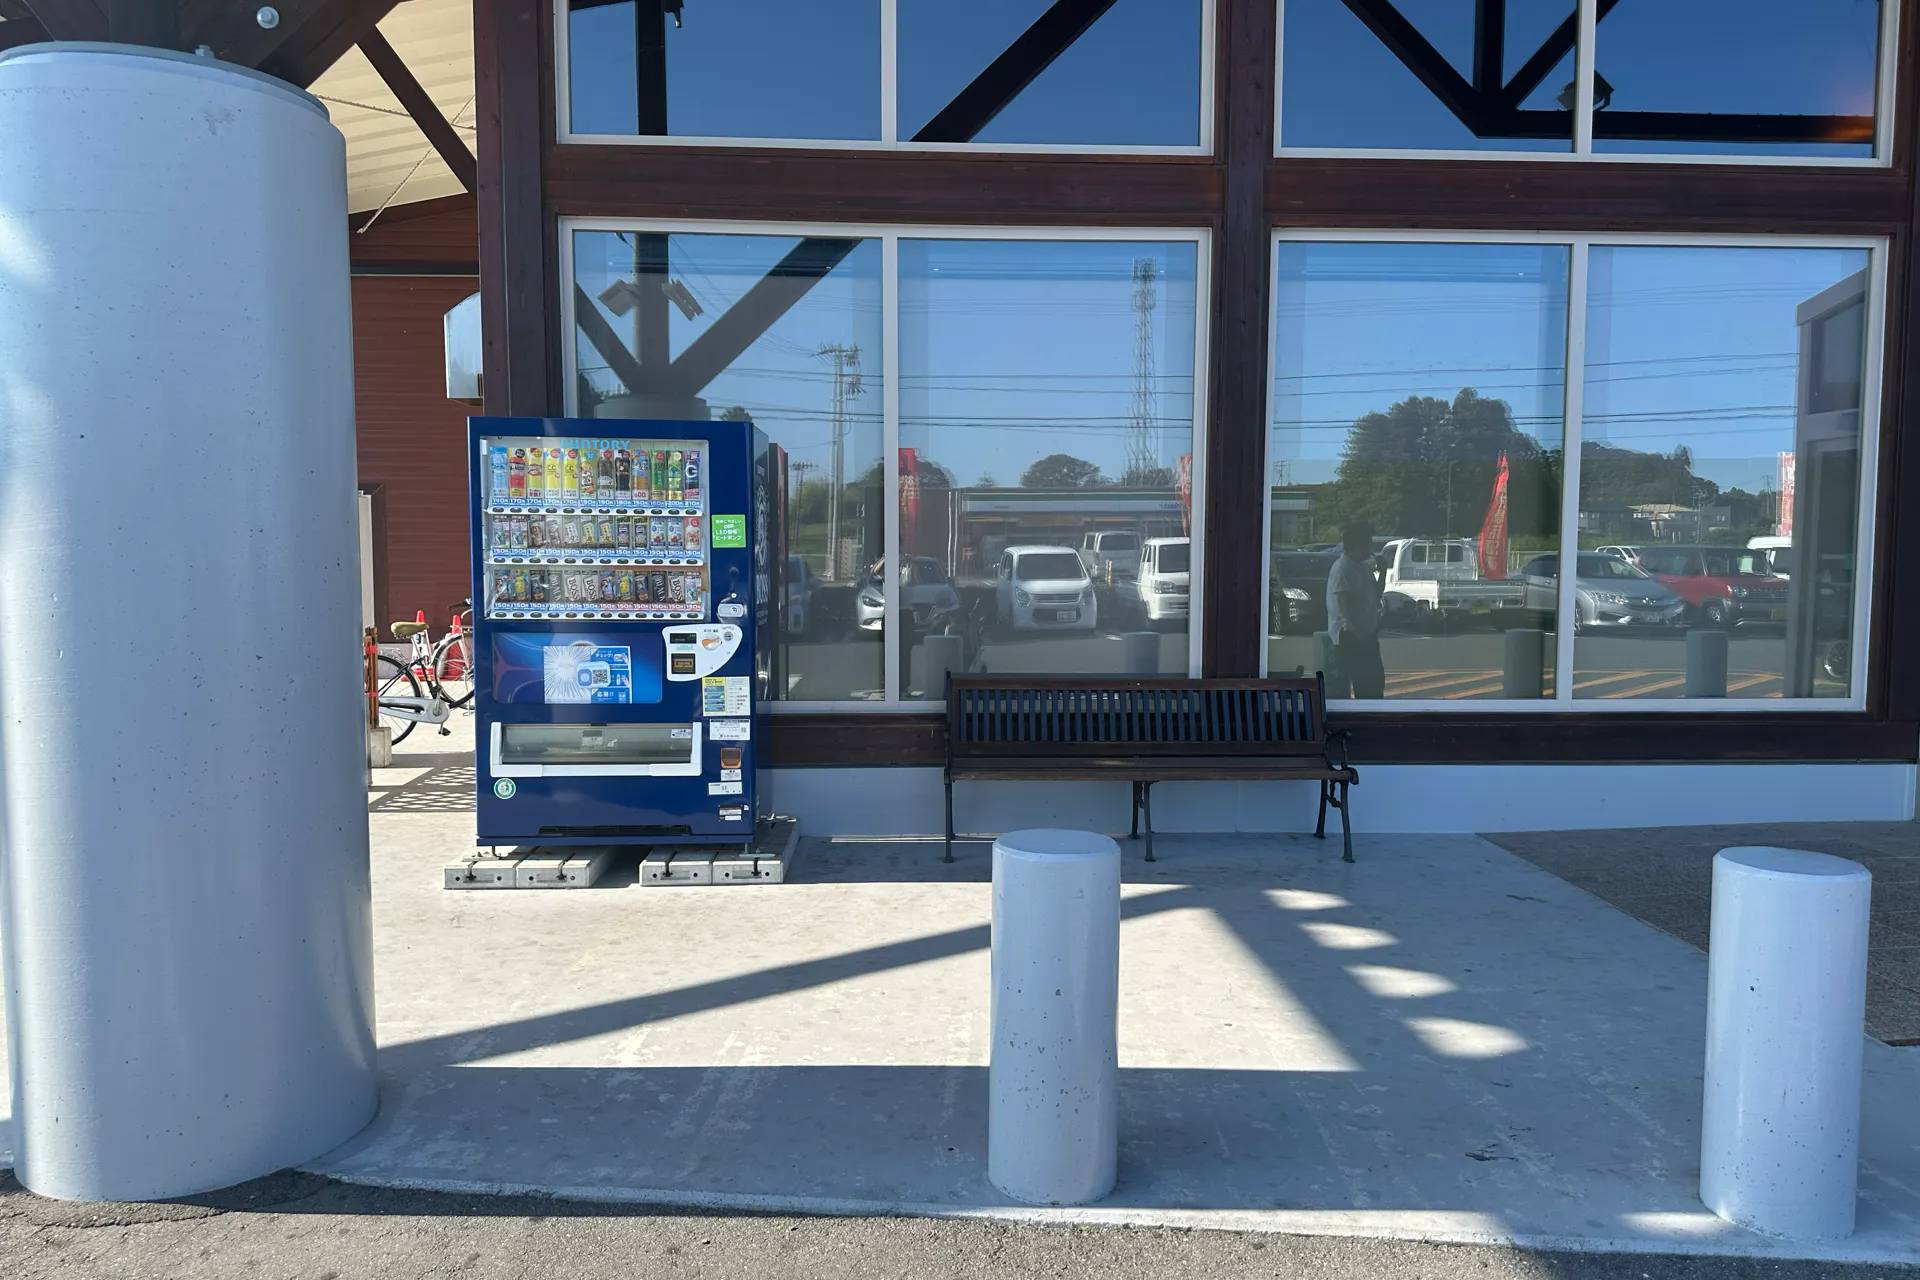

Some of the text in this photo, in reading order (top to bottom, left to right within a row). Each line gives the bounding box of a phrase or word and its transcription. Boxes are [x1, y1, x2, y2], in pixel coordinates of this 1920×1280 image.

[560, 438, 630, 449] SUNTORY
[568, 578, 581, 601] BOSS
[586, 578, 598, 601] BOSS
[672, 579, 684, 601] BOSS
